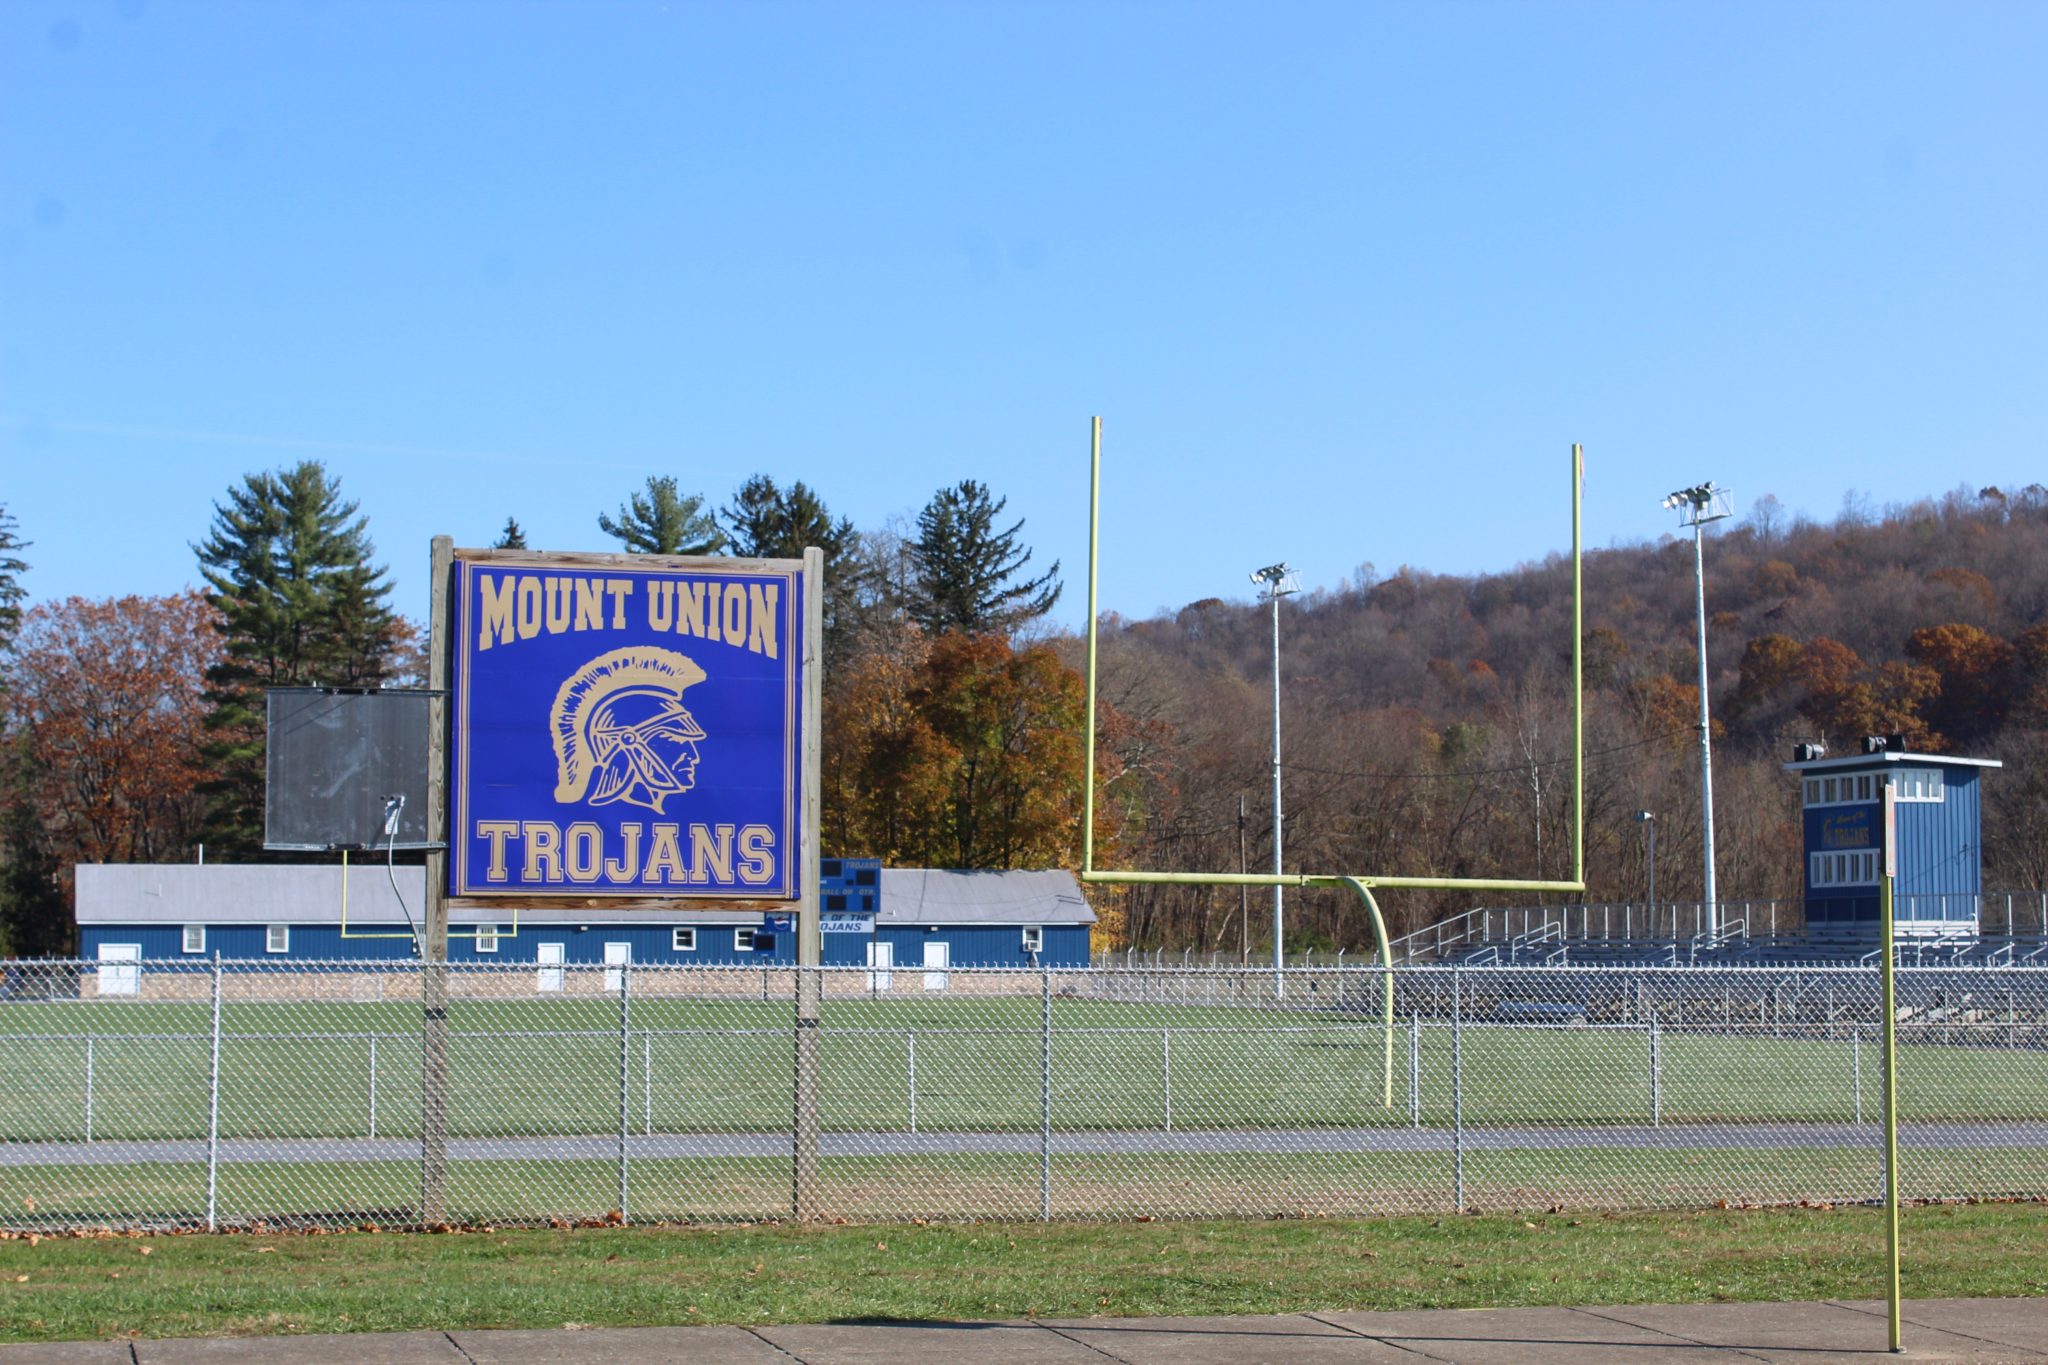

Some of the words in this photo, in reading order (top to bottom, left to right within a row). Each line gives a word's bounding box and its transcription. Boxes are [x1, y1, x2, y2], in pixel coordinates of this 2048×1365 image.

[479, 574, 633, 651] MOUNT
[647, 580, 778, 660] UNION
[477, 820, 776, 885] TROJANS
[820, 922, 862, 931] OJANS
